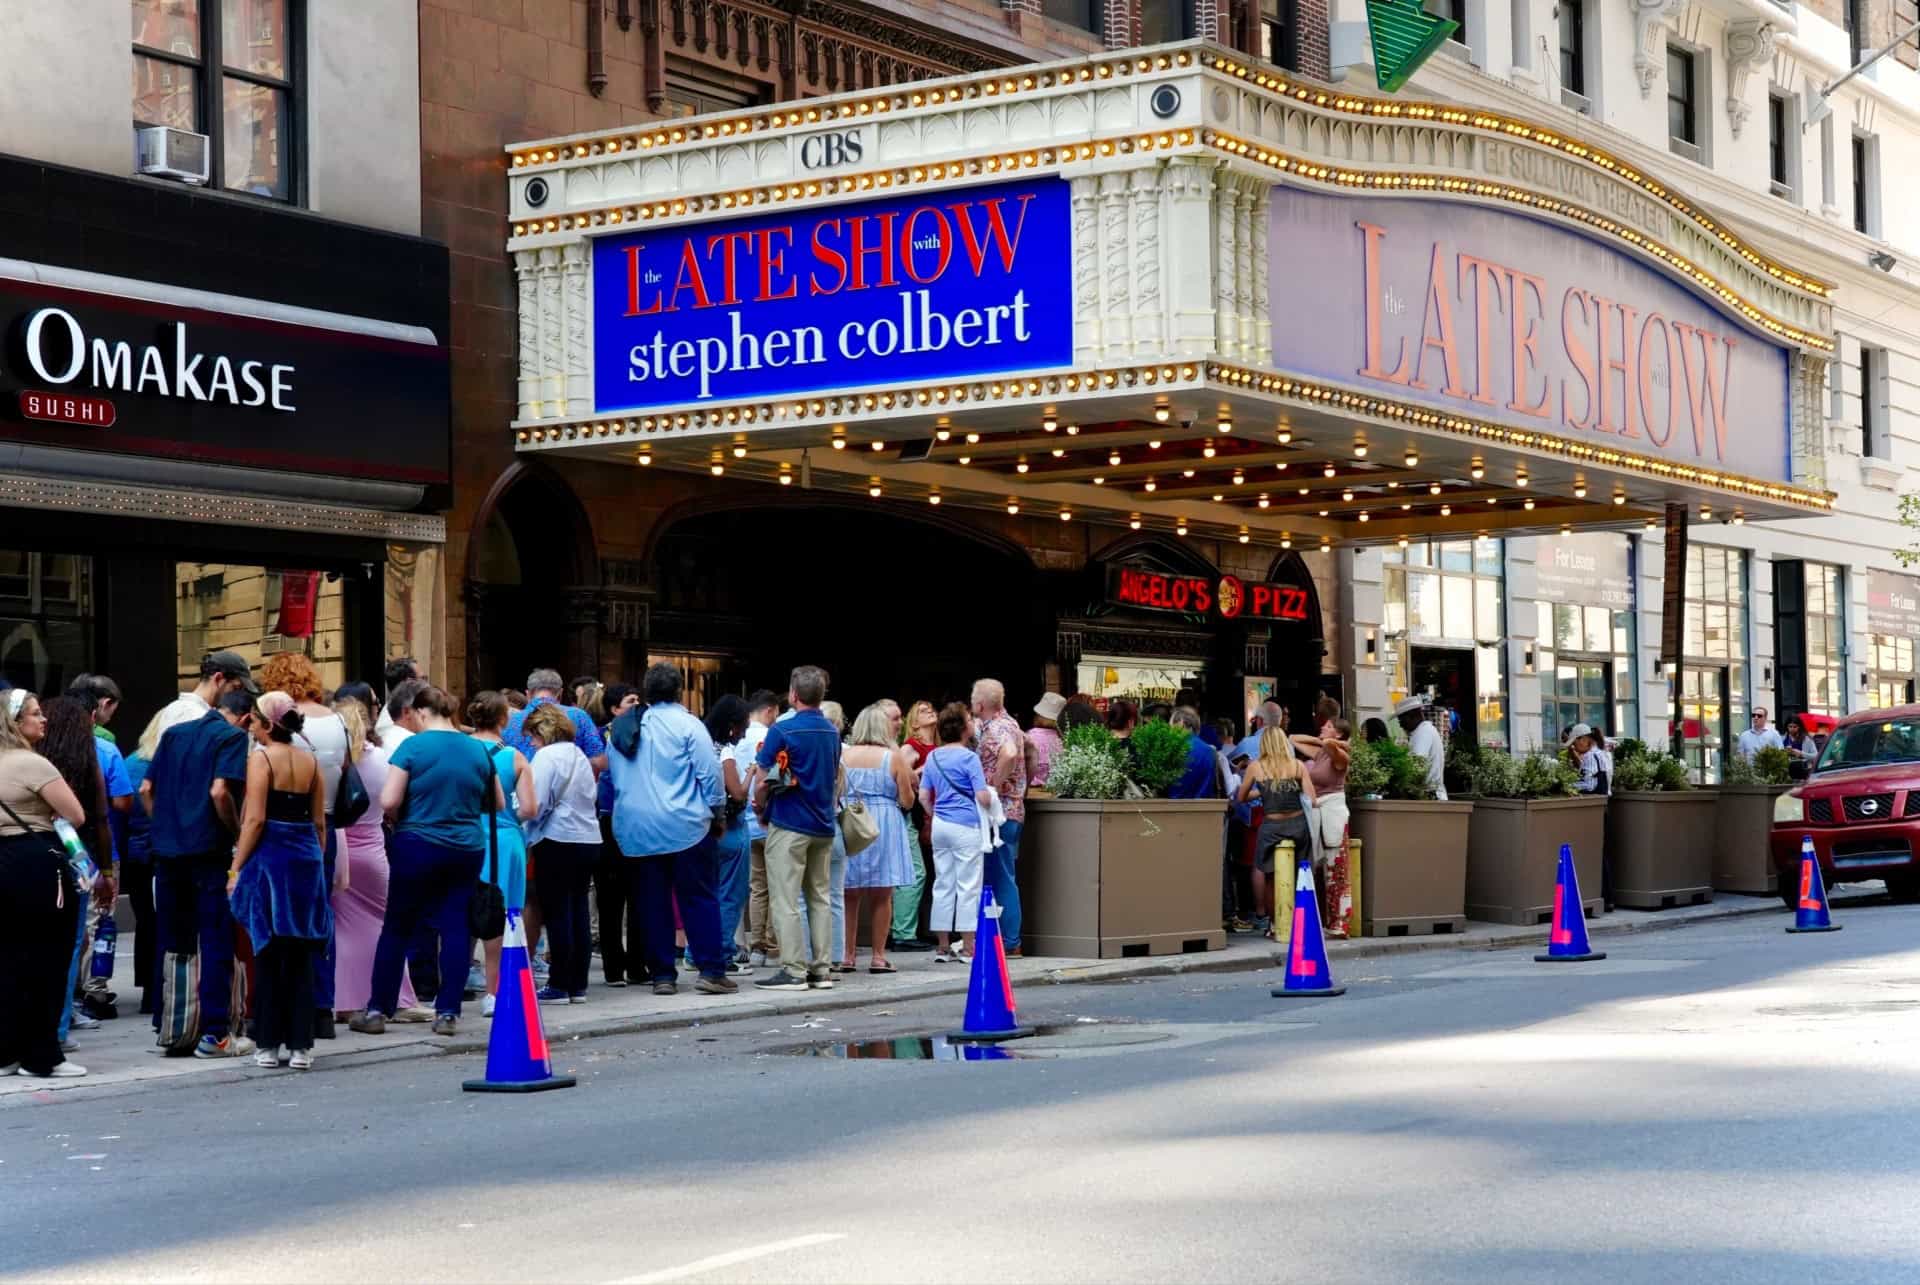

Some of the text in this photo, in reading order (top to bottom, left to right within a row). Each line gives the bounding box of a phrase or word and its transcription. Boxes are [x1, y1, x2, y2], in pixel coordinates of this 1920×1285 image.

[800, 130, 863, 170] CBS
[1594, 178, 1663, 237] THEATER
[622, 194, 1036, 317] LATE SHOW
[913, 233, 941, 250] with
[645, 270, 662, 285] the
[628, 289, 1031, 398] stephen colbert
[1355, 220, 1738, 462] LATE SHOW
[28, 396, 104, 421] SUSHI
[1119, 568, 1211, 612] ANGELO'S
